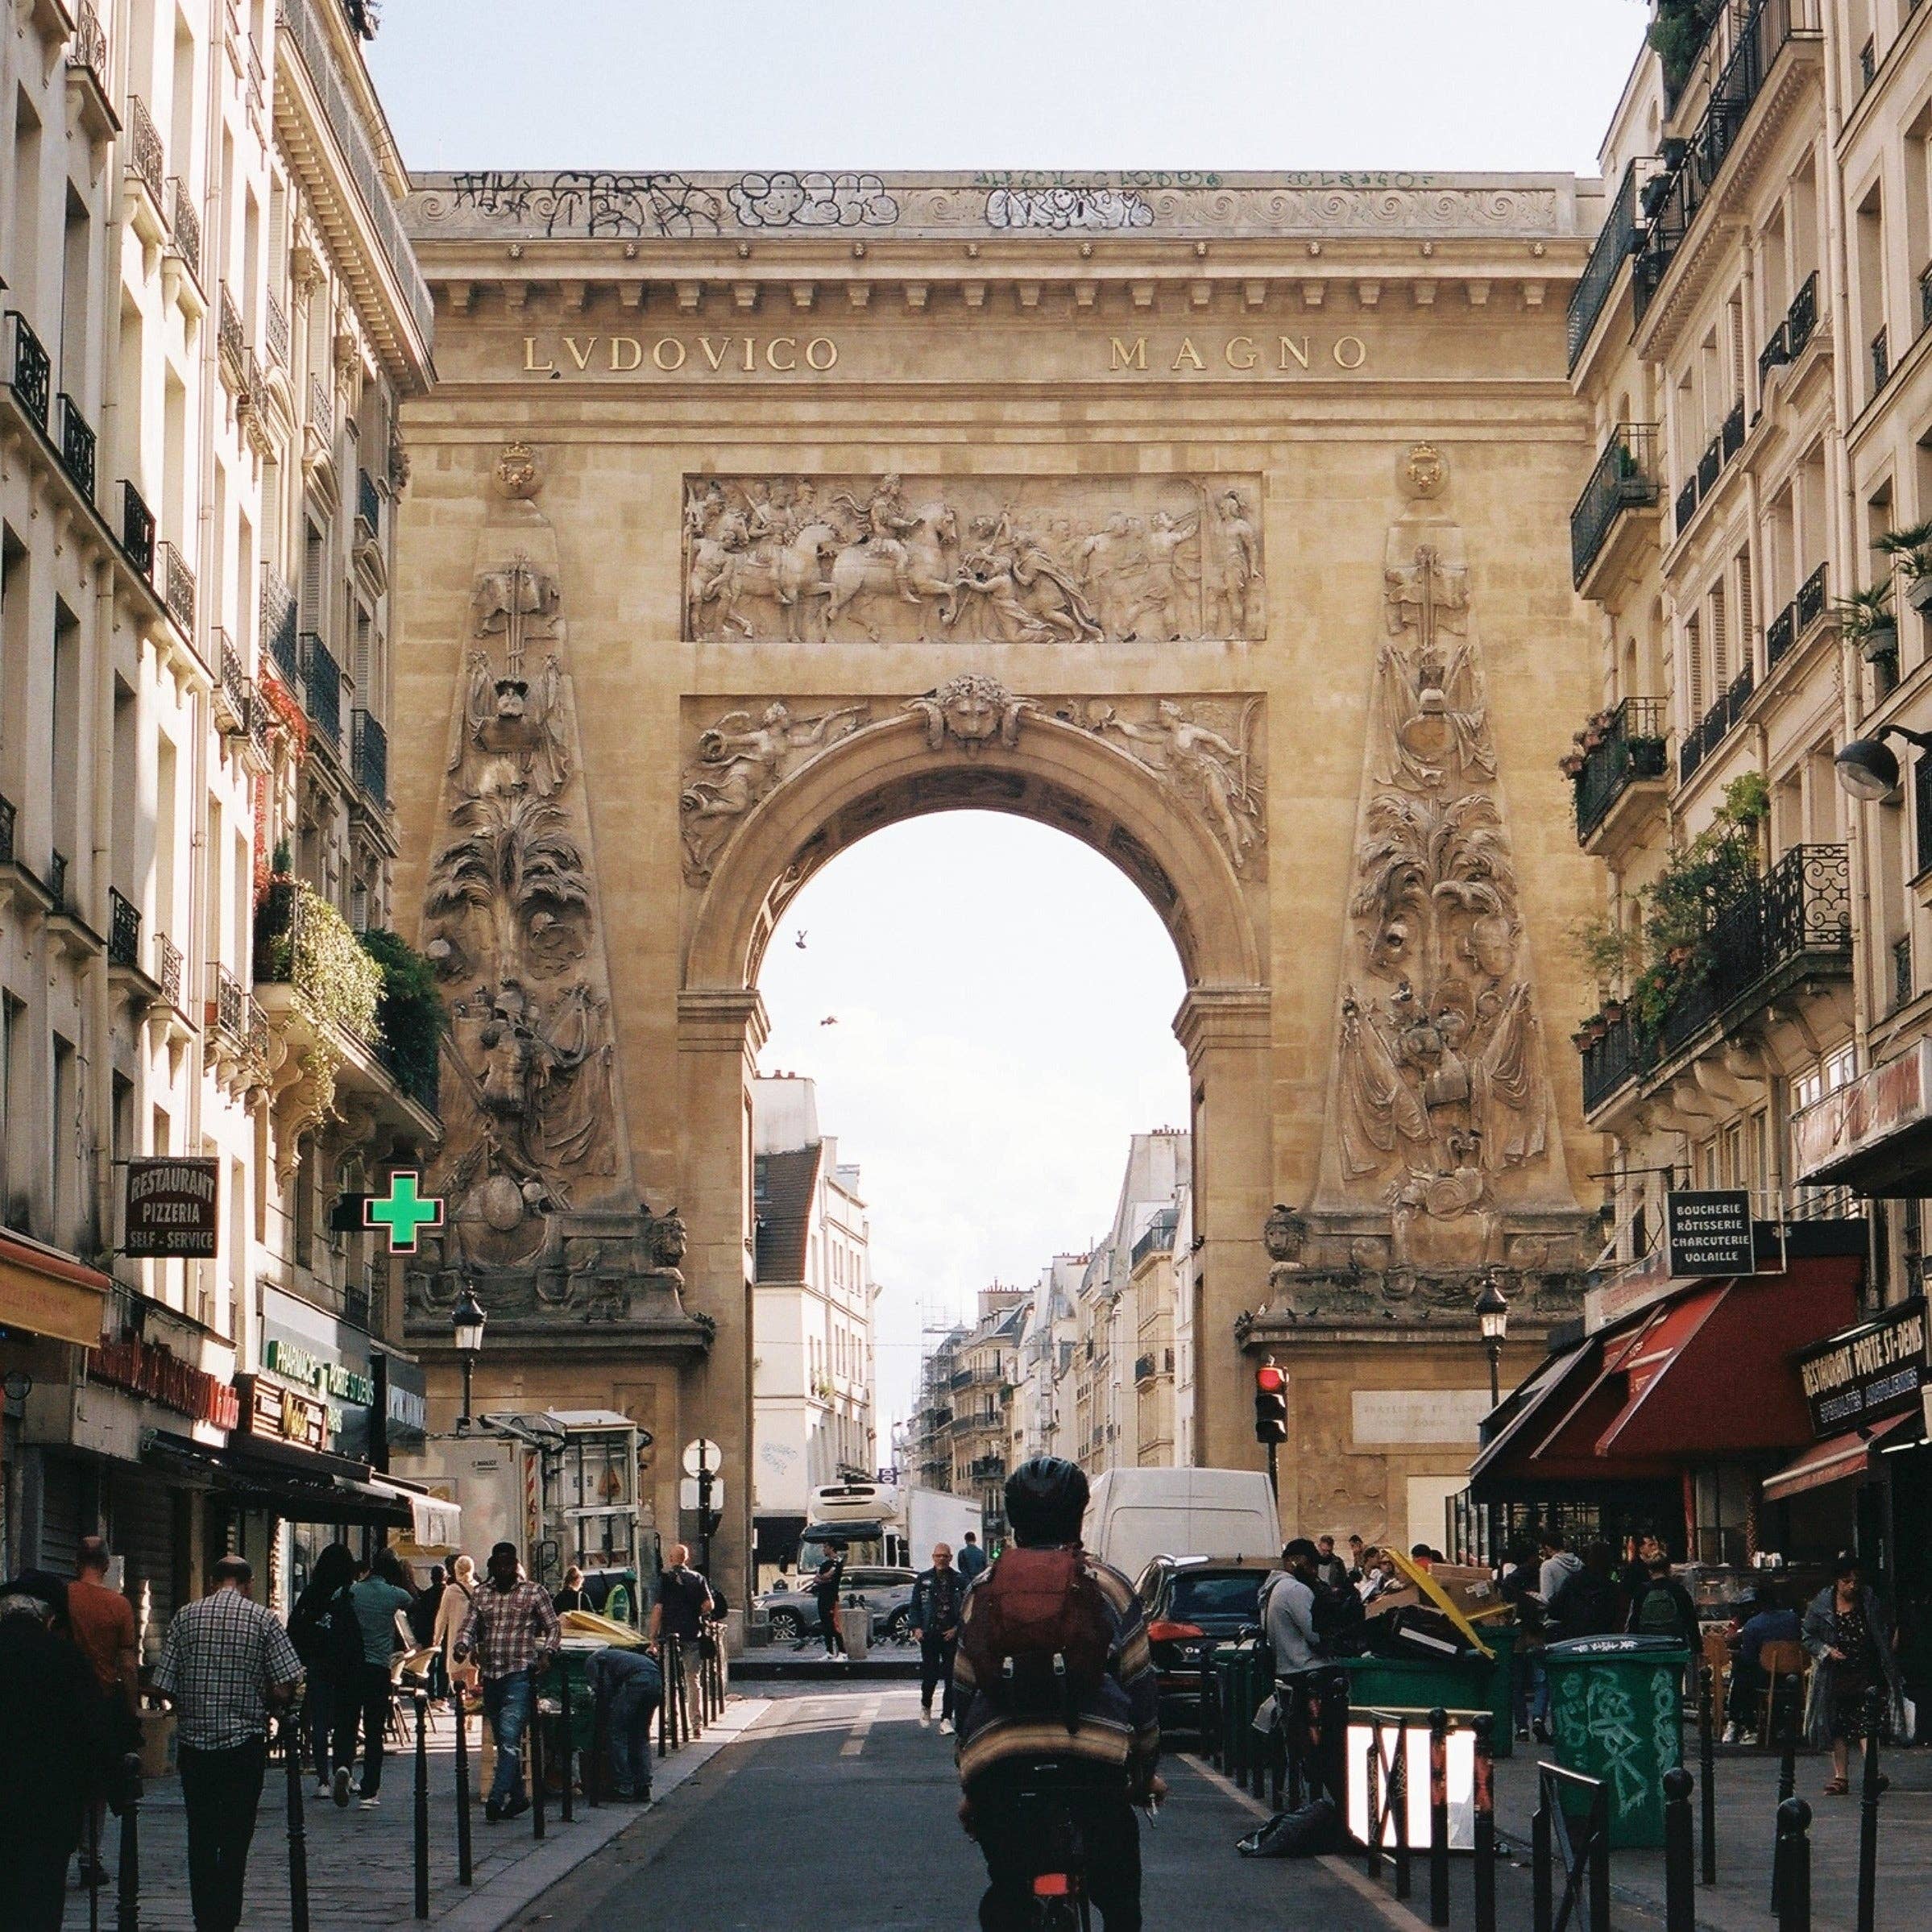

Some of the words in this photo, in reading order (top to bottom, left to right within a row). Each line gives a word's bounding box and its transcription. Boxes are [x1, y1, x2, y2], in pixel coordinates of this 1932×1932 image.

[523, 337, 839, 371] LVDOVICO
[1109, 336, 1366, 370] MAGNO
[131, 1167, 214, 1203] RESTAURANT
[143, 1202, 200, 1223] PIZZERIA
[1677, 1204, 1742, 1216] BOUCHERIE
[1677, 1219, 1743, 1232] RÔTISSERIE
[167, 1230, 214, 1249] SERVICE
[1672, 1235, 1750, 1247] CHARCUTERIE
[1685, 1251, 1739, 1262] VOLAILLE
